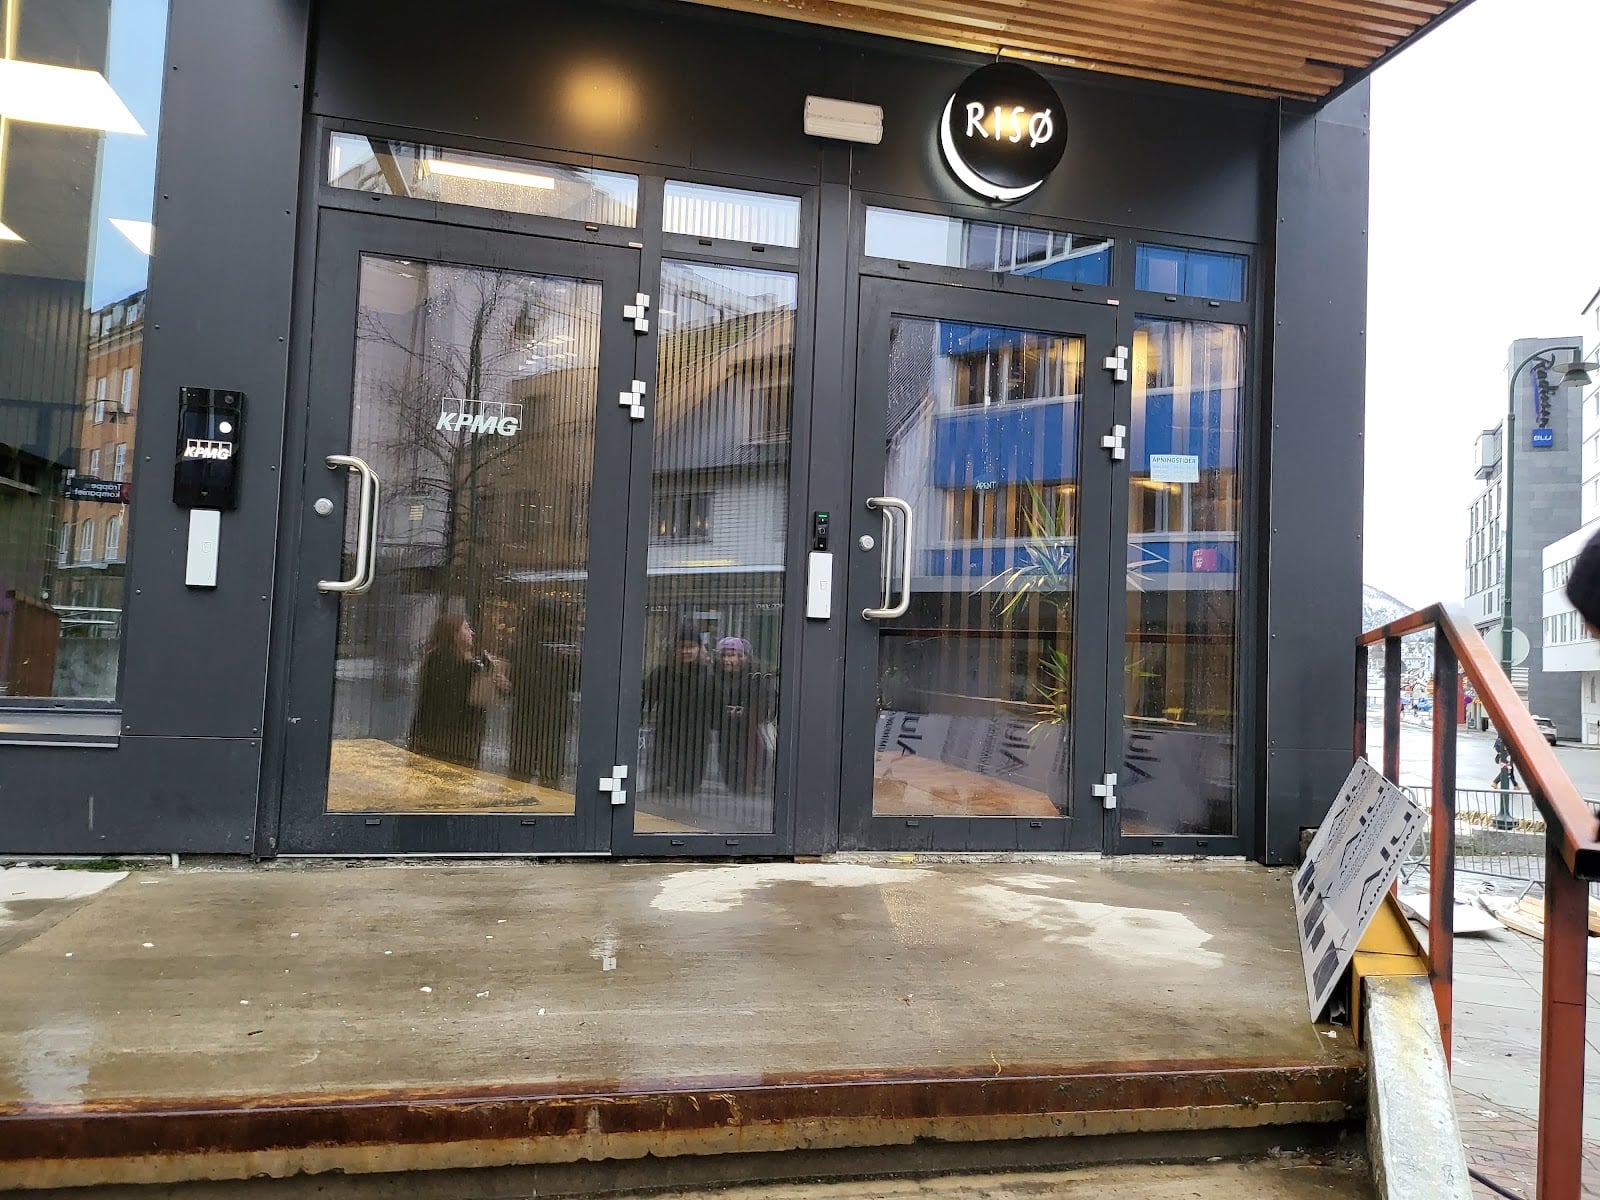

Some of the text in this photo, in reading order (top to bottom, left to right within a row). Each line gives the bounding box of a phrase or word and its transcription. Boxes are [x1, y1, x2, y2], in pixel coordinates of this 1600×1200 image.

[966, 102, 1054, 148] RISØ
[436, 411, 519, 436] KPMG
[184, 445, 230, 460] KPMG
[1357, 825, 1416, 929] ALUMINIUM
